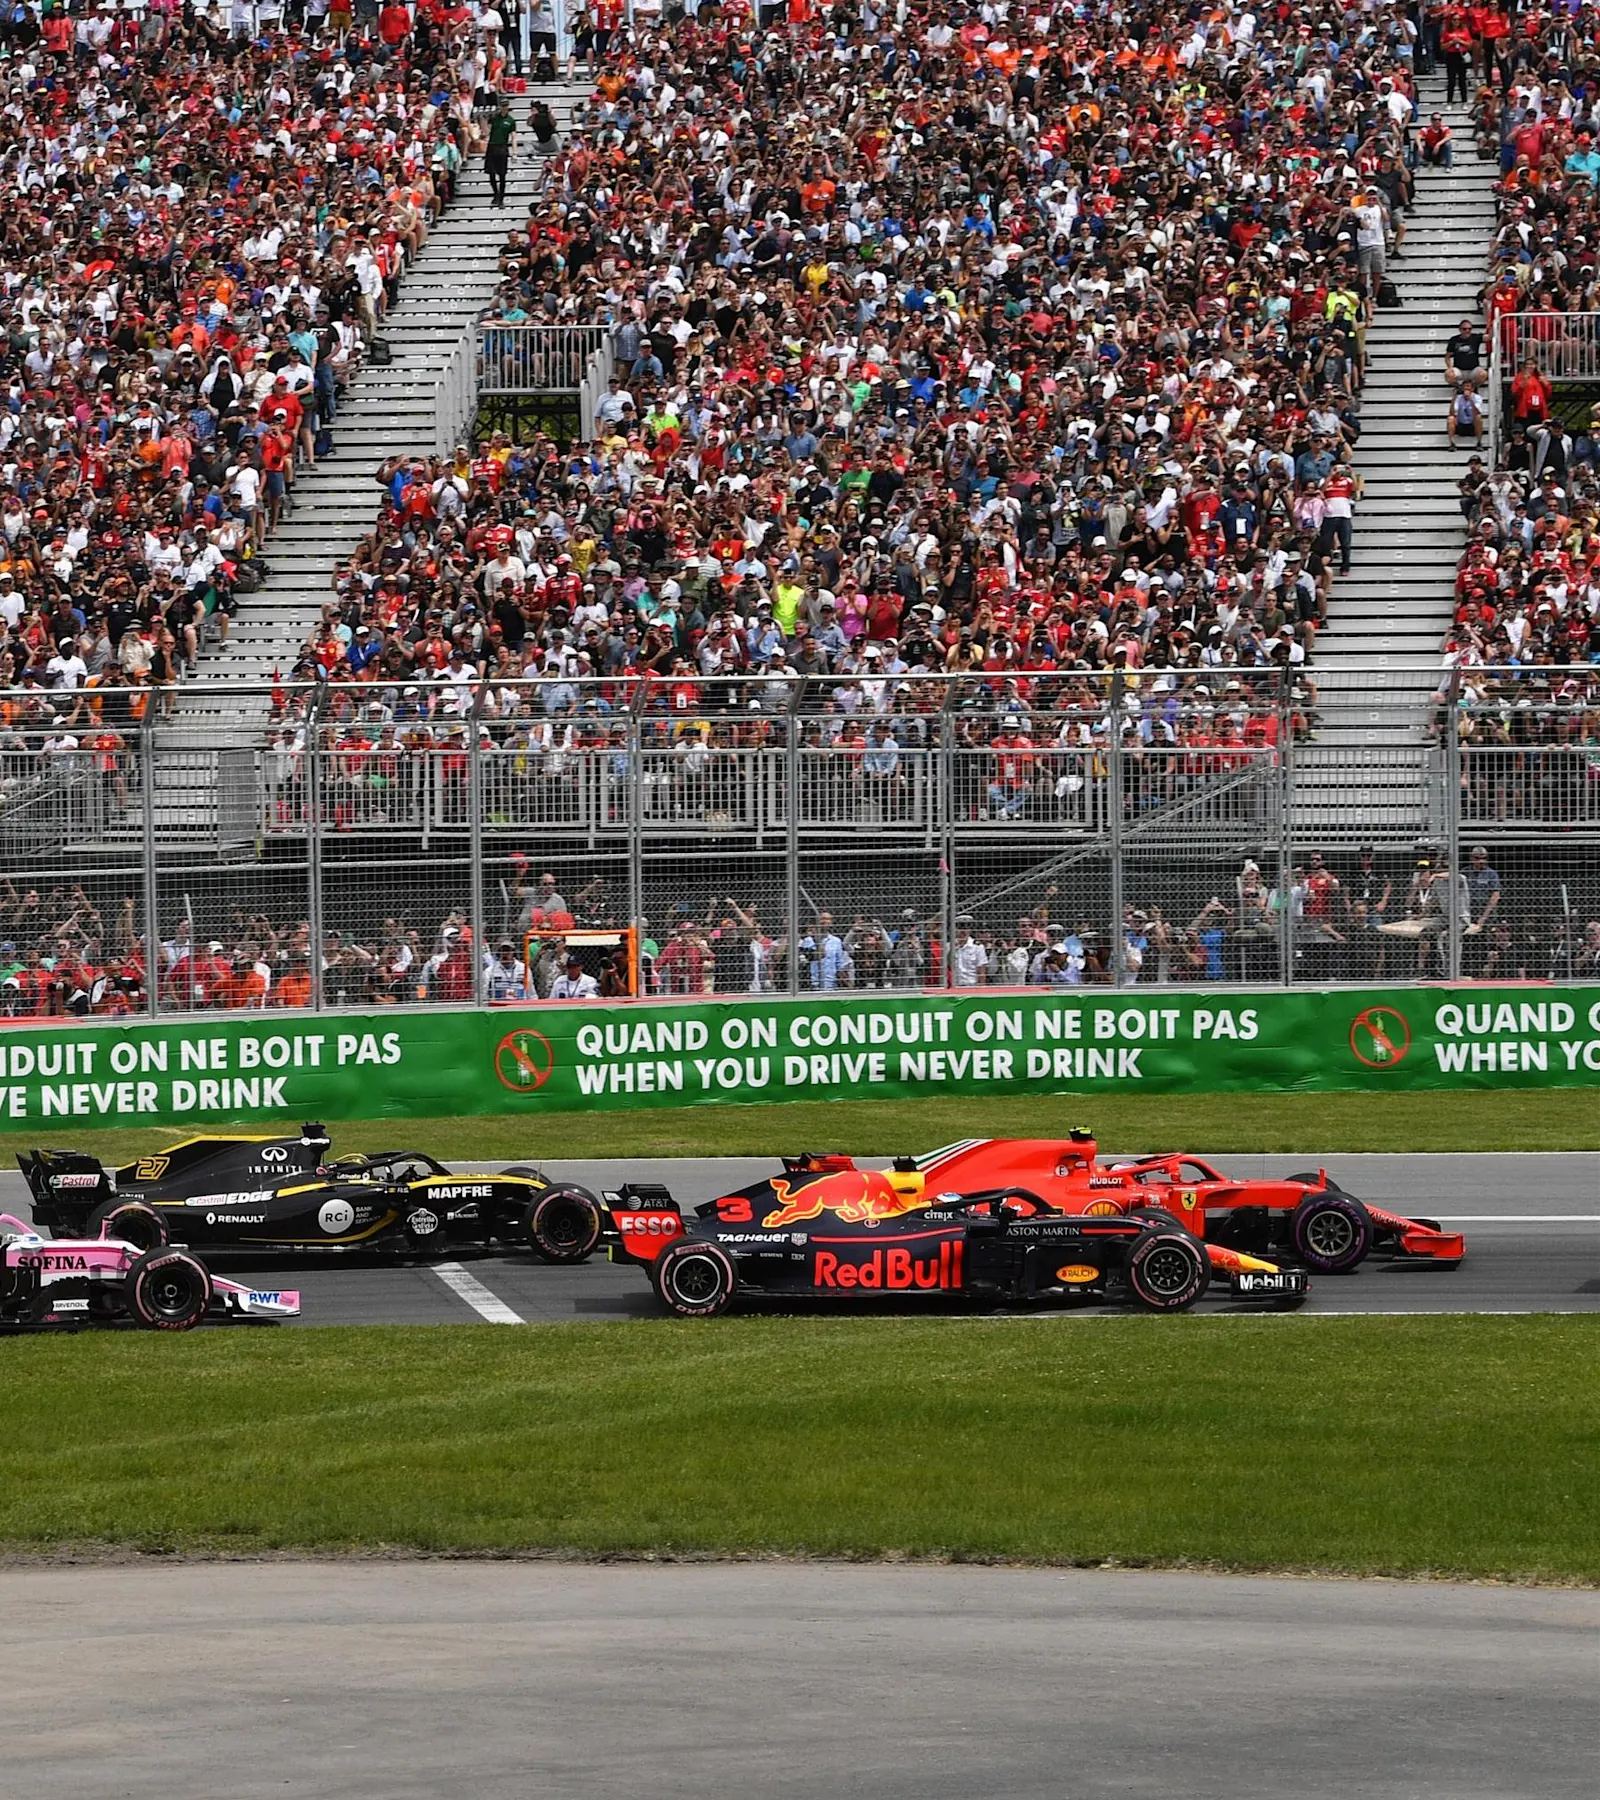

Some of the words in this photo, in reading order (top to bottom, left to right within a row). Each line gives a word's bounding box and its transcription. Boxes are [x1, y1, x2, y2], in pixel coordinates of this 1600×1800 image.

[1435, 1003, 1575, 1037] QUAND
[577, 1021, 708, 1057] QUAND
[722, 1018, 776, 1048] ON
[790, 1012, 952, 1047] CONDUIT
[966, 1011, 1022, 1041] ON
[1036, 1010, 1081, 1039] NE
[1095, 1009, 1179, 1039] BOIT
[1194, 1010, 1258, 1039] PAS
[111, 1041, 167, 1073] ON
[181, 1039, 227, 1070] NE
[240, 1036, 324, 1067] BOIT
[338, 1033, 400, 1064] PAS
[1434, 1041, 1548, 1072] WHEN
[576, 1061, 682, 1094] WHEN
[694, 1057, 769, 1088] YOU
[785, 1053, 885, 1084] DRIVE
[900, 1050, 1013, 1080] NEVER
[1028, 1048, 1142, 1077] DRINK
[42, 1082, 158, 1115] NEVER
[172, 1077, 288, 1110] DRINK
[136, 1156, 170, 1180] 27
[249, 1164, 302, 1174] INFINITI
[62, 1175, 97, 1188] Castrol
[1089, 1176, 1123, 1185] HUBLOT
[226, 1190, 274, 1205] EDGE
[427, 1184, 493, 1200] MAPFRE
[643, 1198, 668, 1208] AT&T
[716, 1197, 753, 1222] 3
[218, 1214, 265, 1224] RENAULT
[621, 1216, 677, 1235] ESSO
[1006, 1227, 1039, 1236] ASTON
[1042, 1226, 1080, 1236] MARTIN
[18, 1255, 88, 1270] SOFINA
[1067, 1269, 1094, 1278] RAUCH
[1239, 1273, 1283, 1291] Mobil
[250, 1292, 280, 1304] BWT
